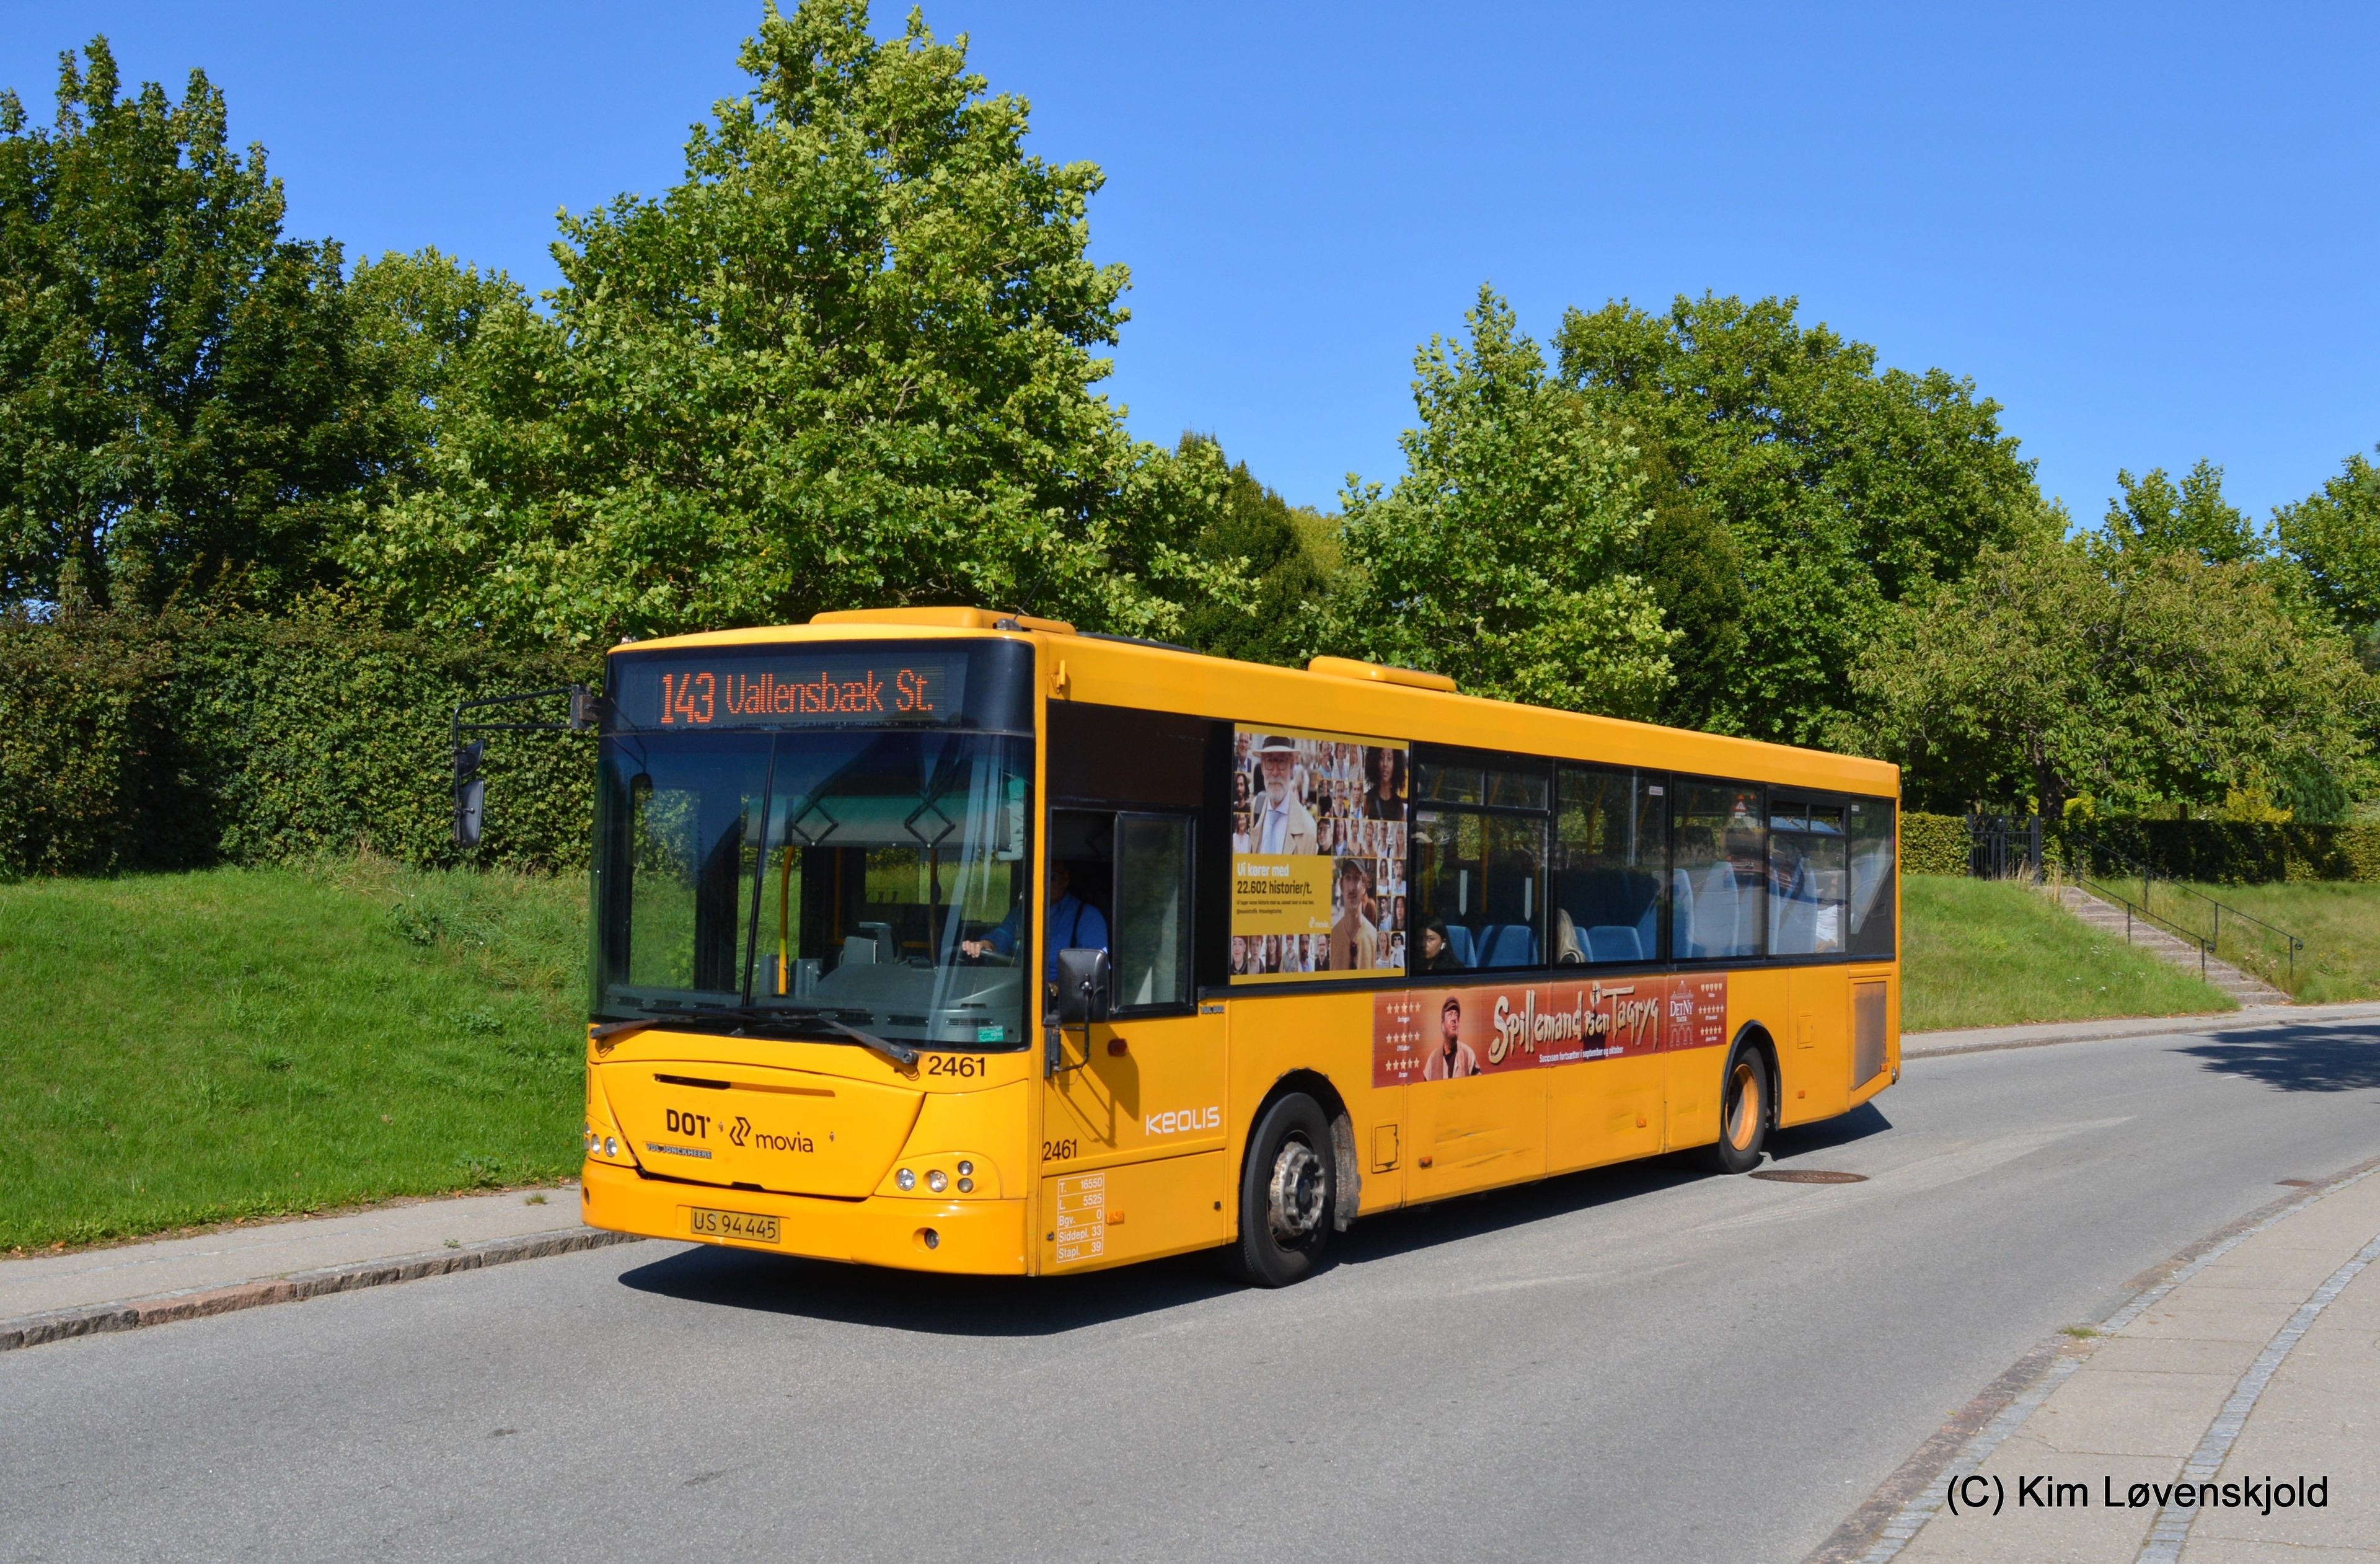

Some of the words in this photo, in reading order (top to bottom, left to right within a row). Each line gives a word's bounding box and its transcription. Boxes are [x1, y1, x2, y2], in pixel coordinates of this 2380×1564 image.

[661, 673, 715, 723] 143
[726, 671, 883, 714] Vallensbæk
[896, 669, 933, 711] St.
[1272, 864, 1289, 877] med
[1237, 880, 1267, 895] 22.602
[1269, 880, 1312, 896] historier/t.
[1488, 989, 1583, 1064] Spillemand
[1601, 985, 1659, 1051] Tagryg
[1582, 1047, 1603, 1059] september
[1603, 1048, 1609, 1057] og
[1609, 1045, 1624, 1054] oktober
[928, 1055, 985, 1077] 2461
[756, 1131, 813, 1153] movia
[1042, 1138, 1077, 1161] 2461
[662, 1145, 712, 1159] JONCKHEERE
[1060, 1182, 1067, 1193] T.
[1080, 1177, 1103, 1190] 16550
[1083, 1193, 1102, 1206] 5525
[694, 1212, 716, 1231] US
[1059, 1216, 1075, 1227] Bgv.
[1096, 1209, 1102, 1219] 0
[1059, 1228, 1089, 1243] Siddepl.
[1091, 1225, 1101, 1237] 33
[1059, 1245, 1080, 1259] Stapl.
[1091, 1241, 1101, 1253] 39
